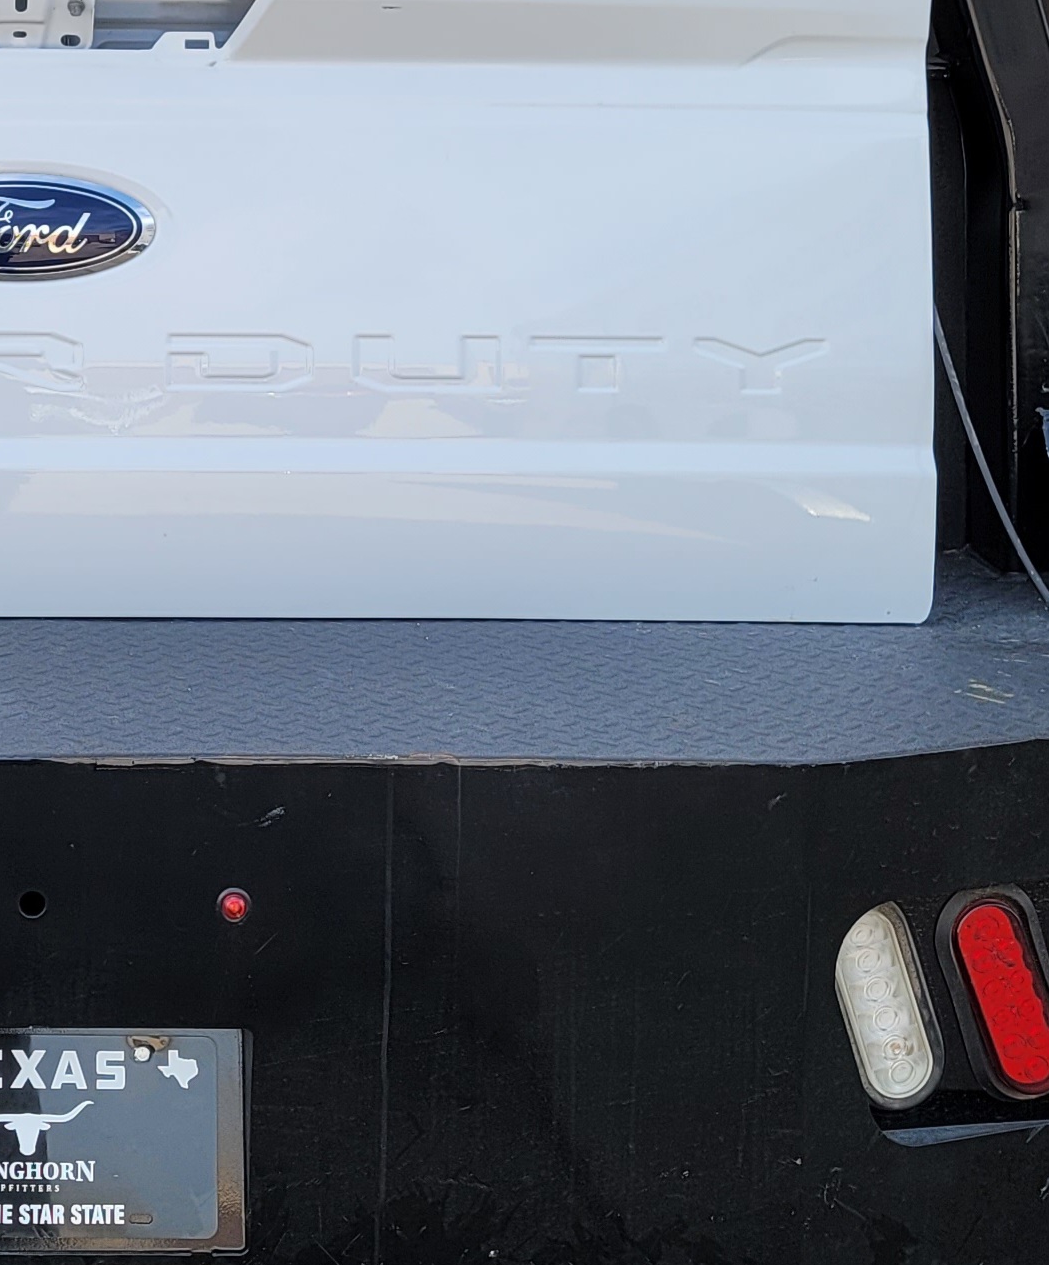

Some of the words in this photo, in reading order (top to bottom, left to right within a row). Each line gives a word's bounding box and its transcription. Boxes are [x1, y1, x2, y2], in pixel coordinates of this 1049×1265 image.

[165, 332, 831, 395] DUTY
[18, 1204, 65, 1225] STAR
[70, 1204, 125, 1225] STATE
